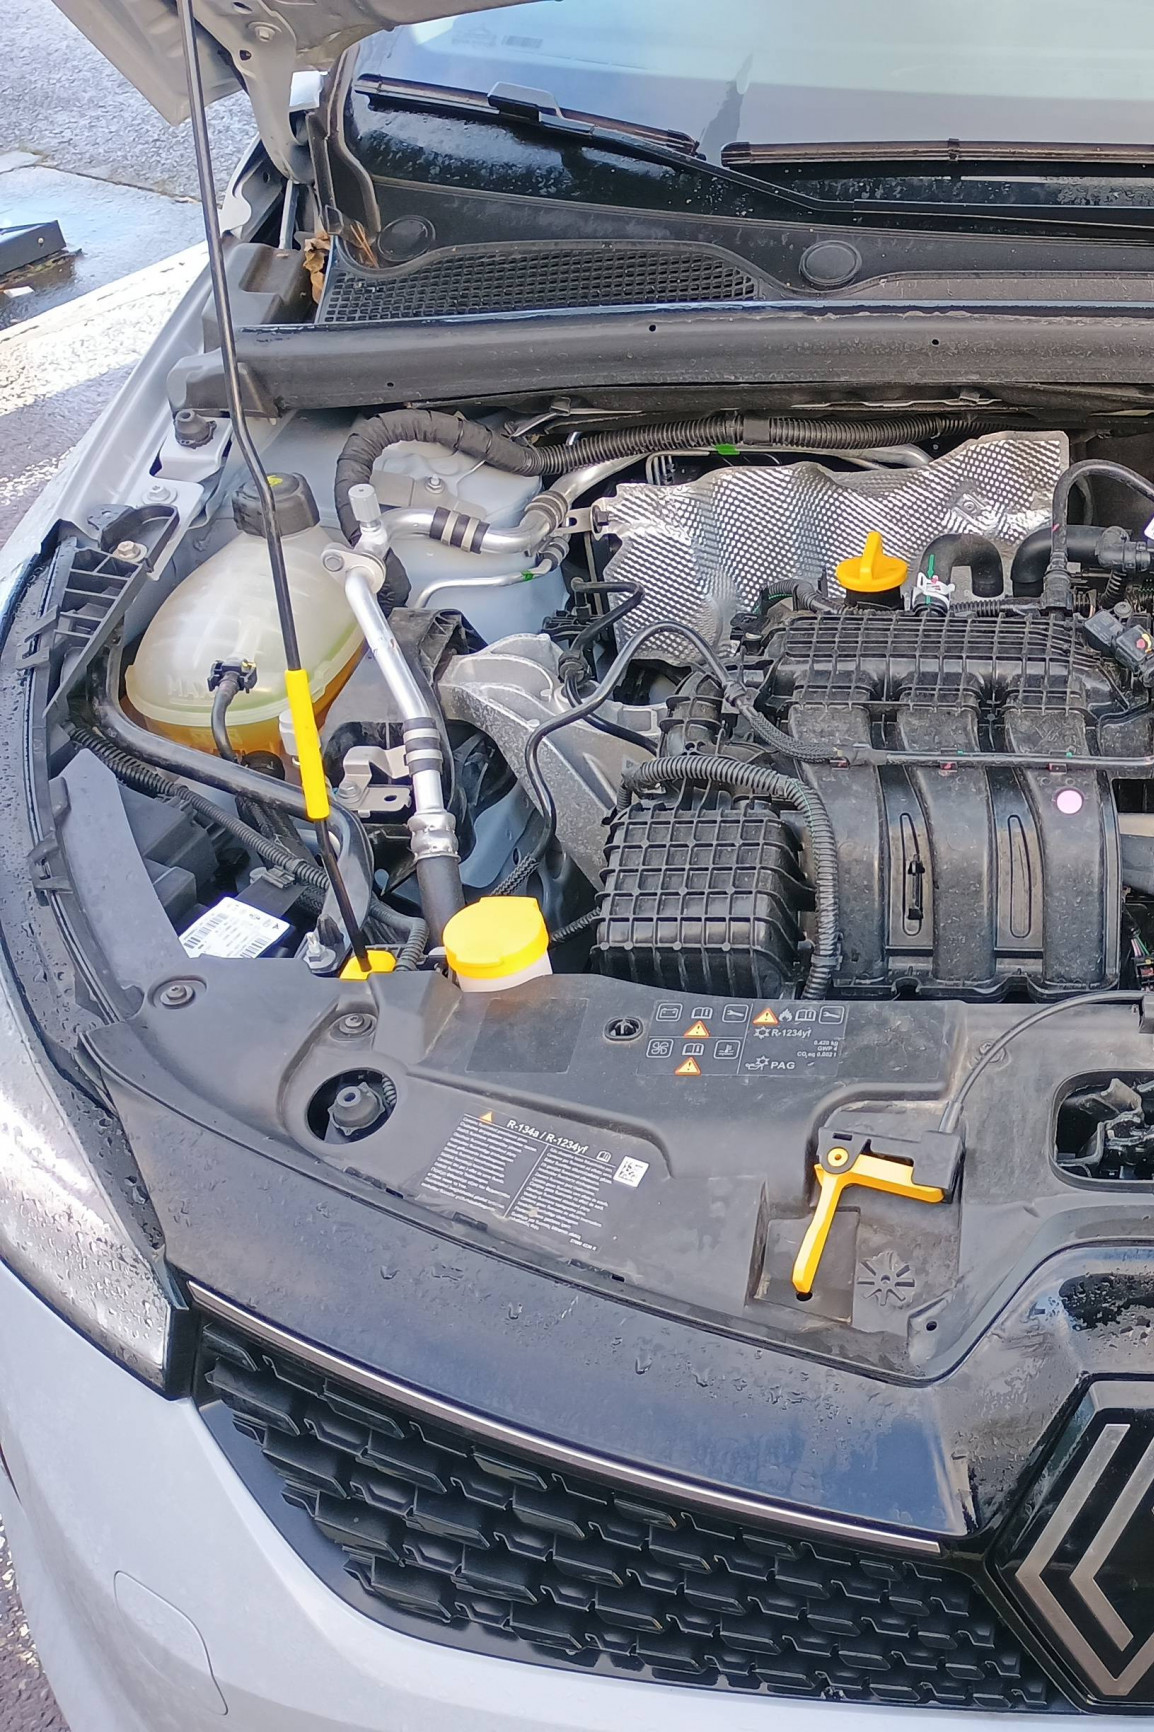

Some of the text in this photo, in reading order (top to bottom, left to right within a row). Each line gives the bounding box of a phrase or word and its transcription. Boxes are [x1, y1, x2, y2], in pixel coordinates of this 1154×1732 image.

[771, 1029, 811, 1038] R-1234yf
[770, 1061, 795, 1070] PAG
[506, 1119, 540, 1138] R-134a
[545, 1133, 589, 1154] R-1234yf
